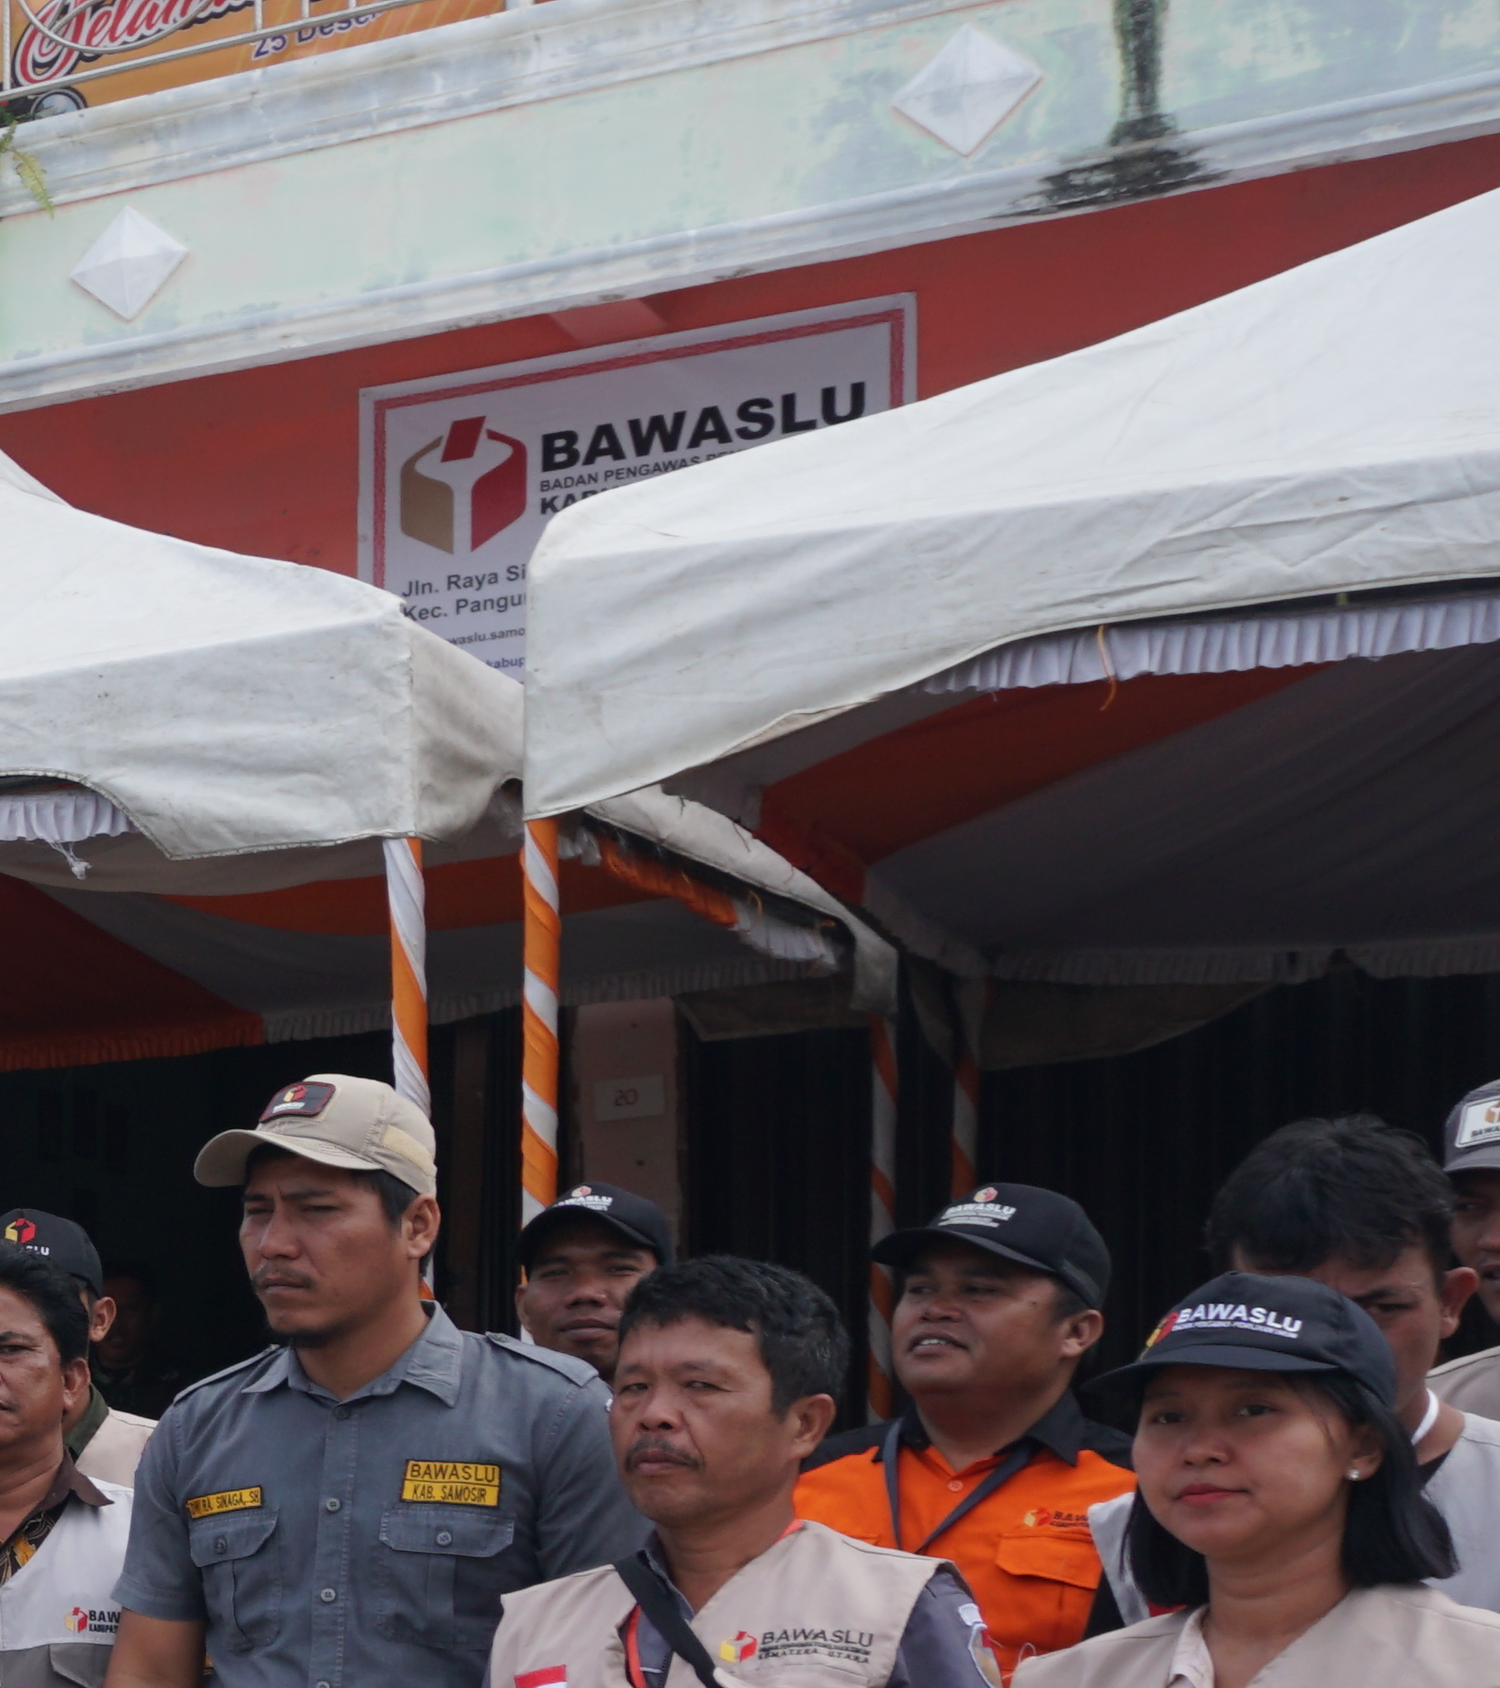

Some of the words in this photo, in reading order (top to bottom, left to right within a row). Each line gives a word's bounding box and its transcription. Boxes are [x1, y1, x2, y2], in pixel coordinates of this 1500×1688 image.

[540, 382, 866, 473] BAWASLU
[540, 473, 598, 492] BADAN
[604, 456, 700, 481] PENGAWAS
[402, 578, 439, 598] Jln.
[446, 571, 499, 593] Raya
[506, 564, 526, 583] Si
[403, 604, 448, 621] Kec.
[456, 592, 526, 615] Pangu
[1176, 1303, 1302, 1332] BAWASLU
[410, 1464, 496, 1482] BAWASLU
[413, 1484, 435, 1499] KAB.
[439, 1485, 486, 1502] SAMOSIR
[88, 1610, 120, 1623] BAW
[760, 1628, 874, 1647] BAWASLU
